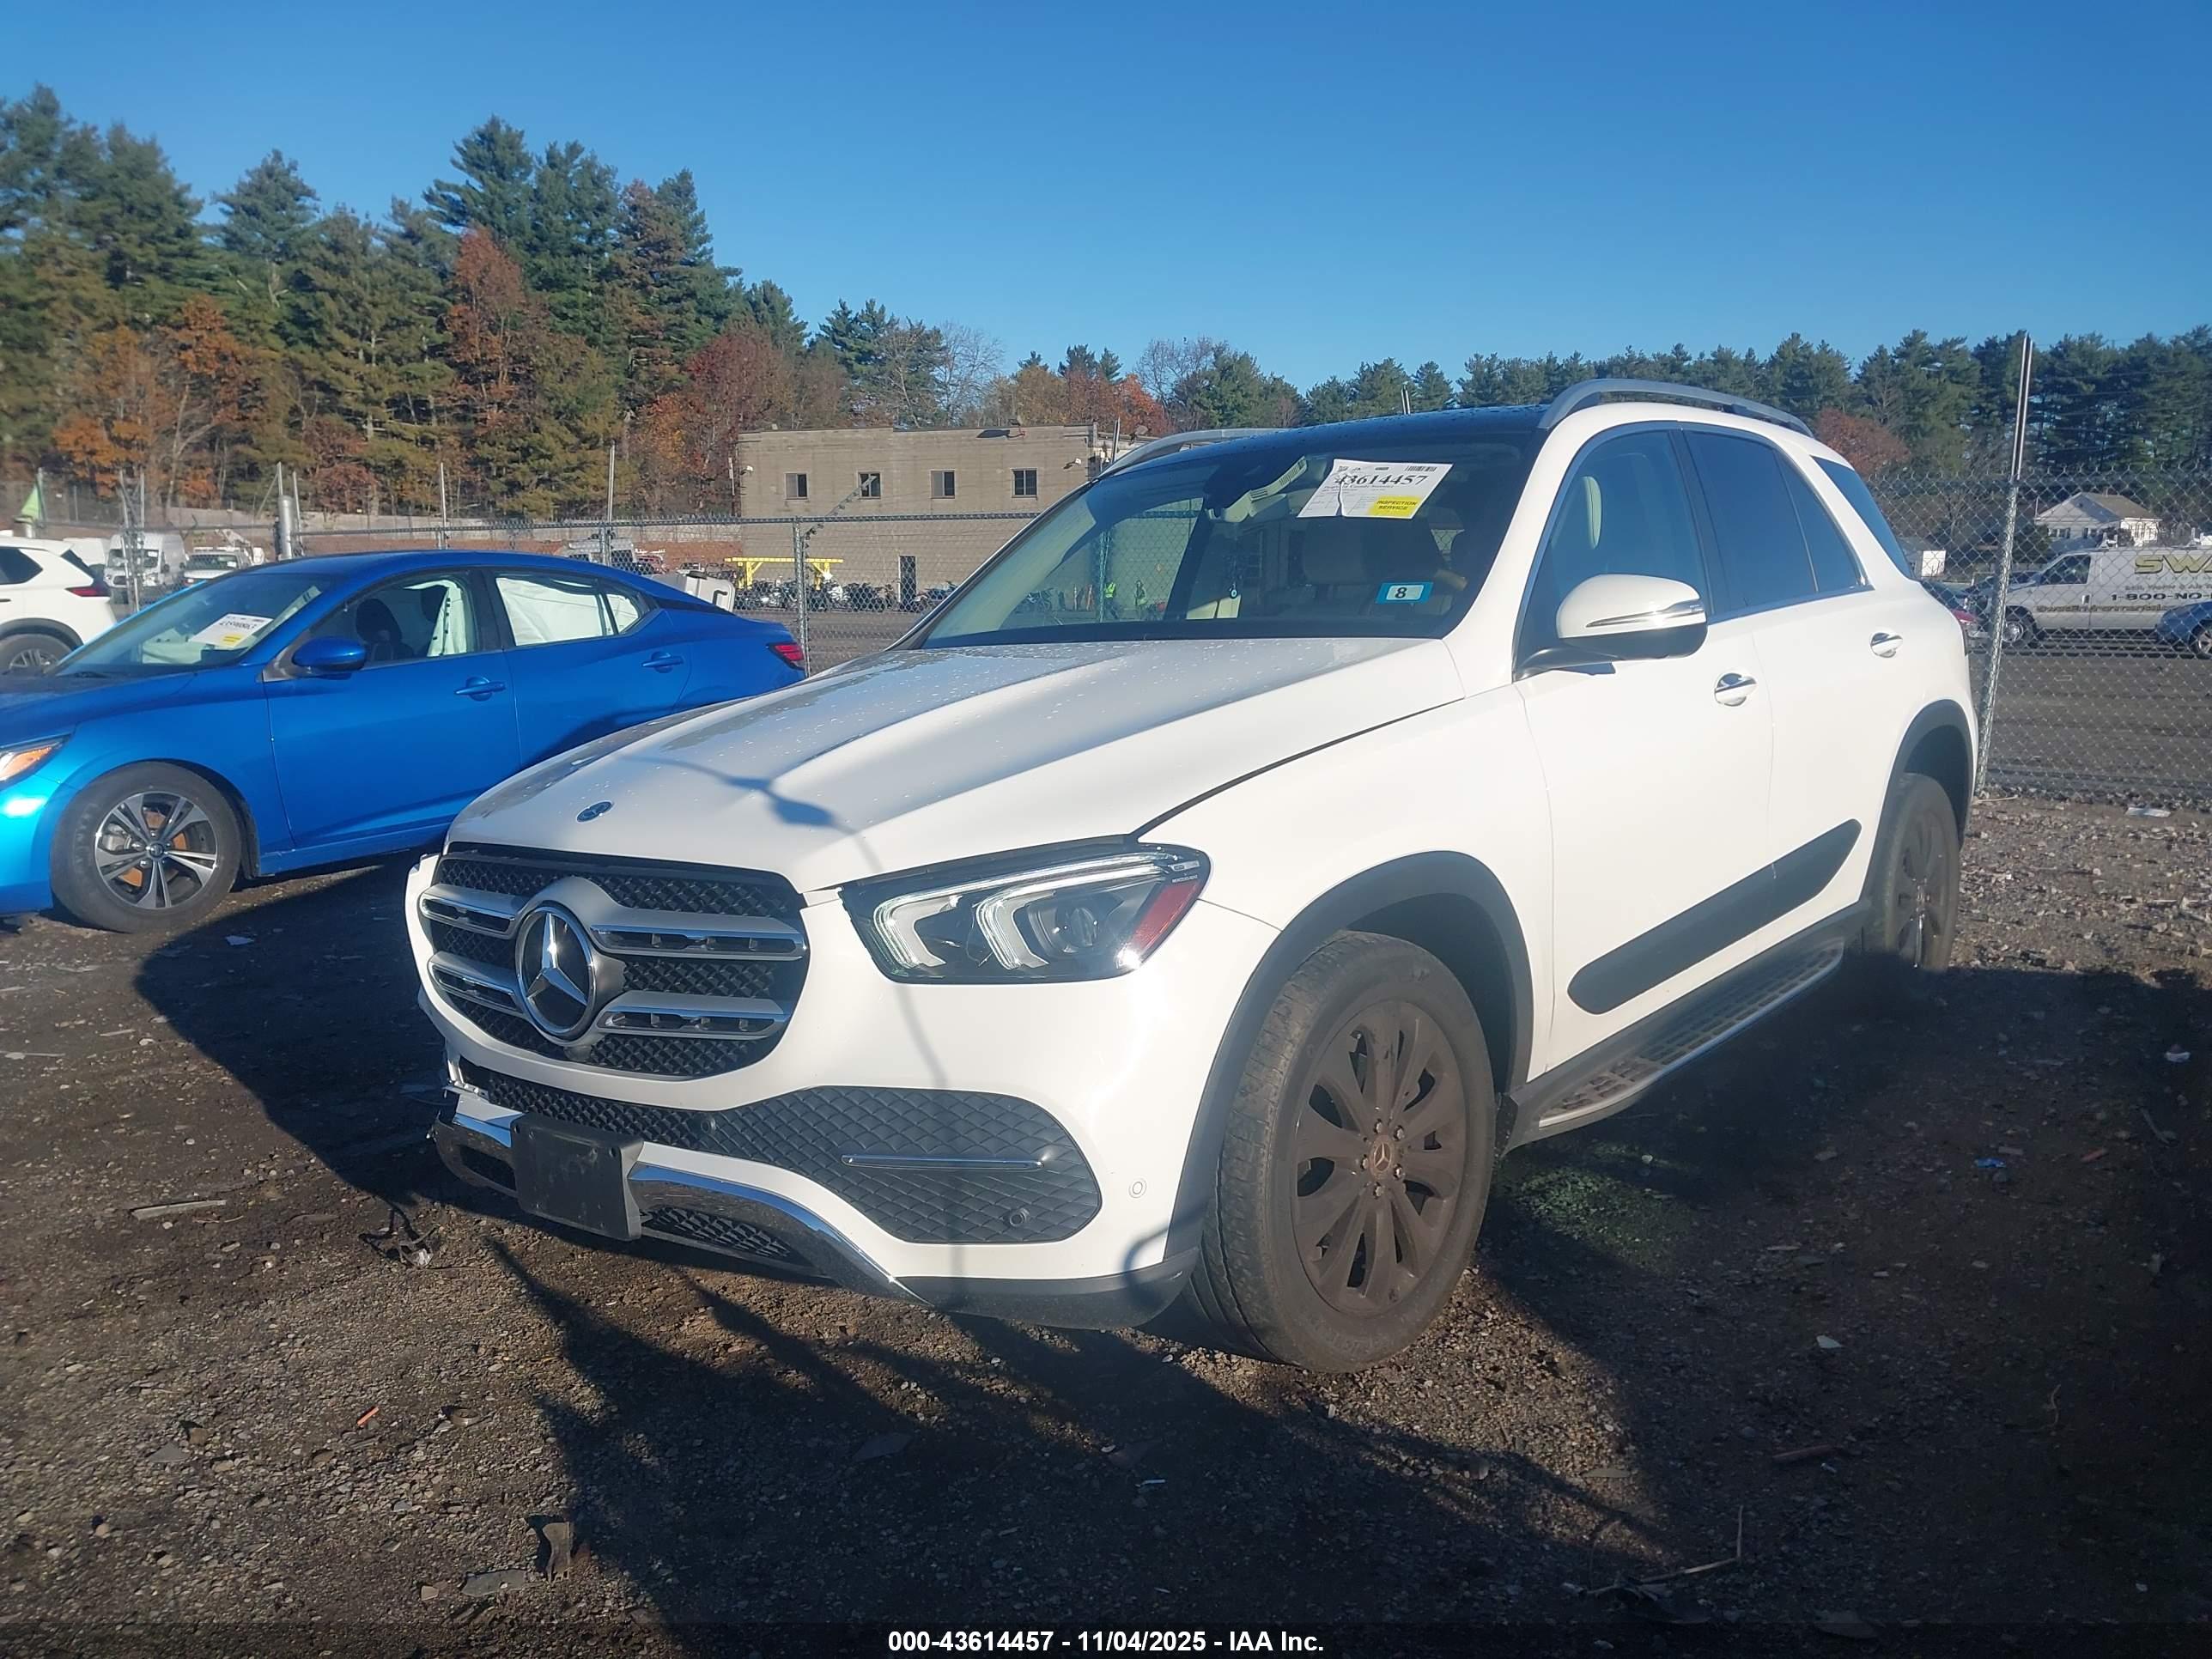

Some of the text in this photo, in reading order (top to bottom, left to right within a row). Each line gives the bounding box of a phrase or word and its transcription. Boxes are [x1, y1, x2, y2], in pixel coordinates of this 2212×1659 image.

[1335, 474, 1428, 485] 43614457
[2135, 555, 2212, 574] SW
[1395, 587, 1407, 599] 8
[2112, 592, 2212, 601] 1-800-NO-
